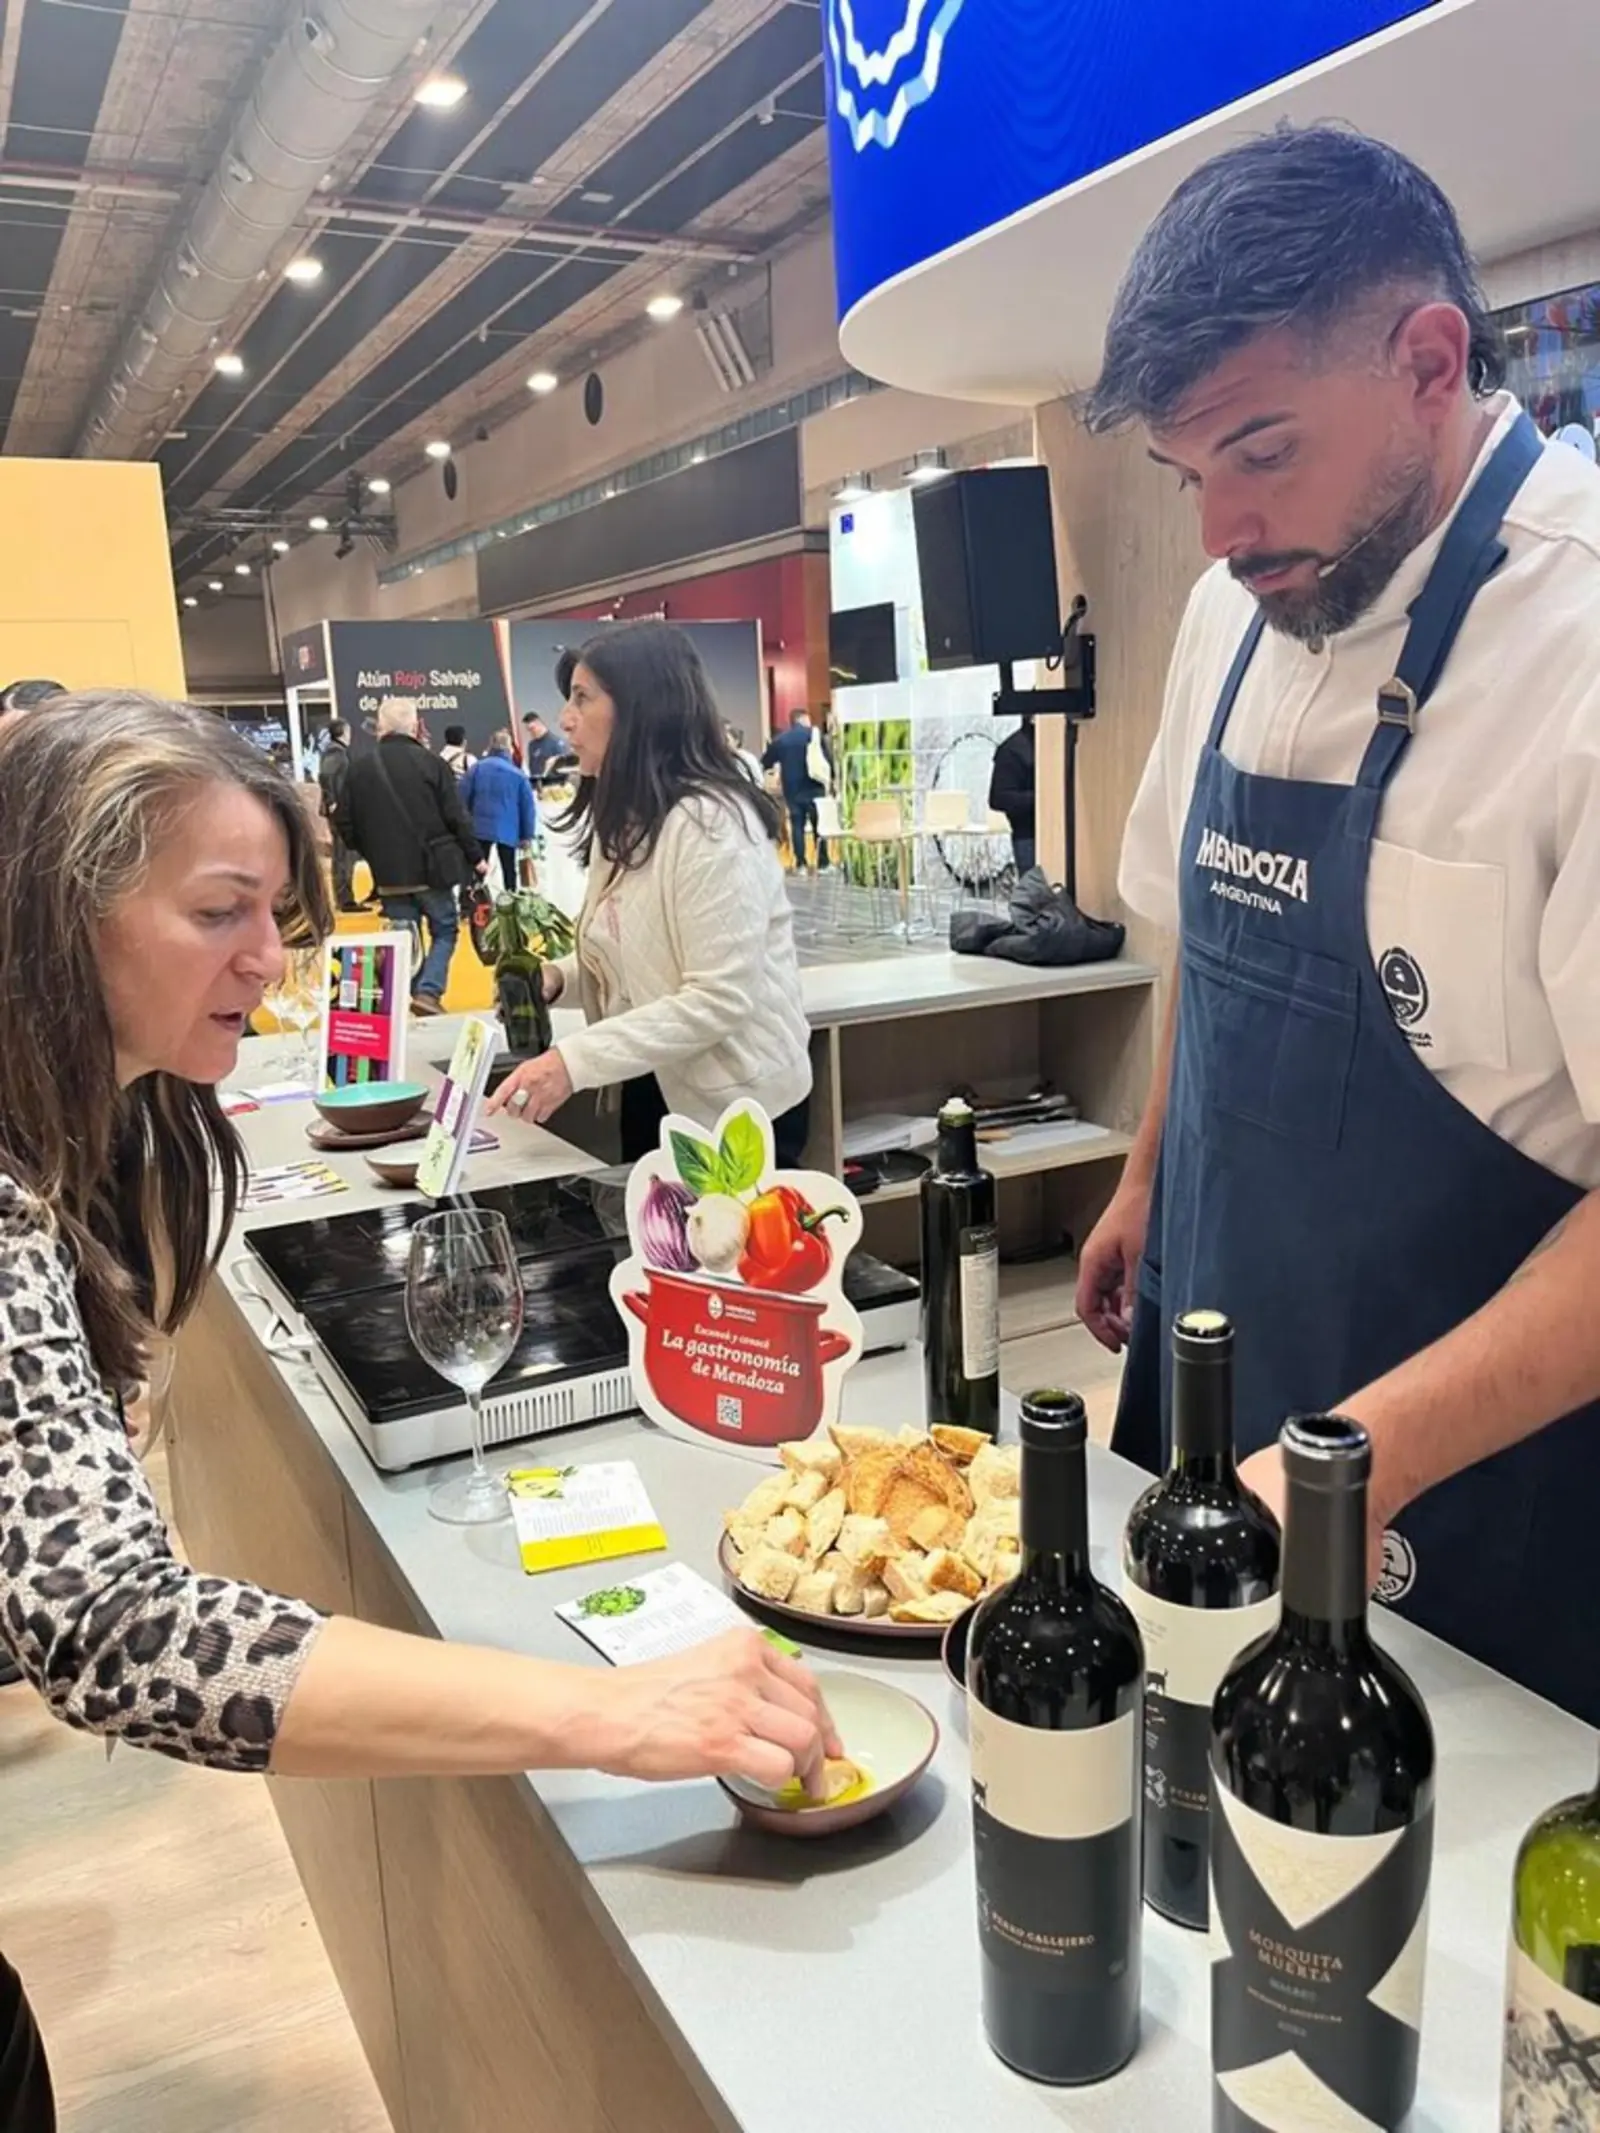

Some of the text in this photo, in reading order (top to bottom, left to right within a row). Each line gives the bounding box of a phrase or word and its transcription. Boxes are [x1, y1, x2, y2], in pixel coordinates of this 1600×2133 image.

[394, 669, 426, 690] Rojo
[429, 669, 481, 689] Salvaje
[360, 694, 378, 711] de
[1195, 827, 1308, 903] MENDOZA
[1210, 879, 1283, 916] ARGENTINA
[661, 1328, 801, 1378] La gastronomía
[729, 1334, 739, 1344] y
[691, 1357, 784, 1394] de Mendoza
[1248, 1928, 1343, 1971] MOSQUITA
[1257, 1948, 1332, 1983] MUERTA
